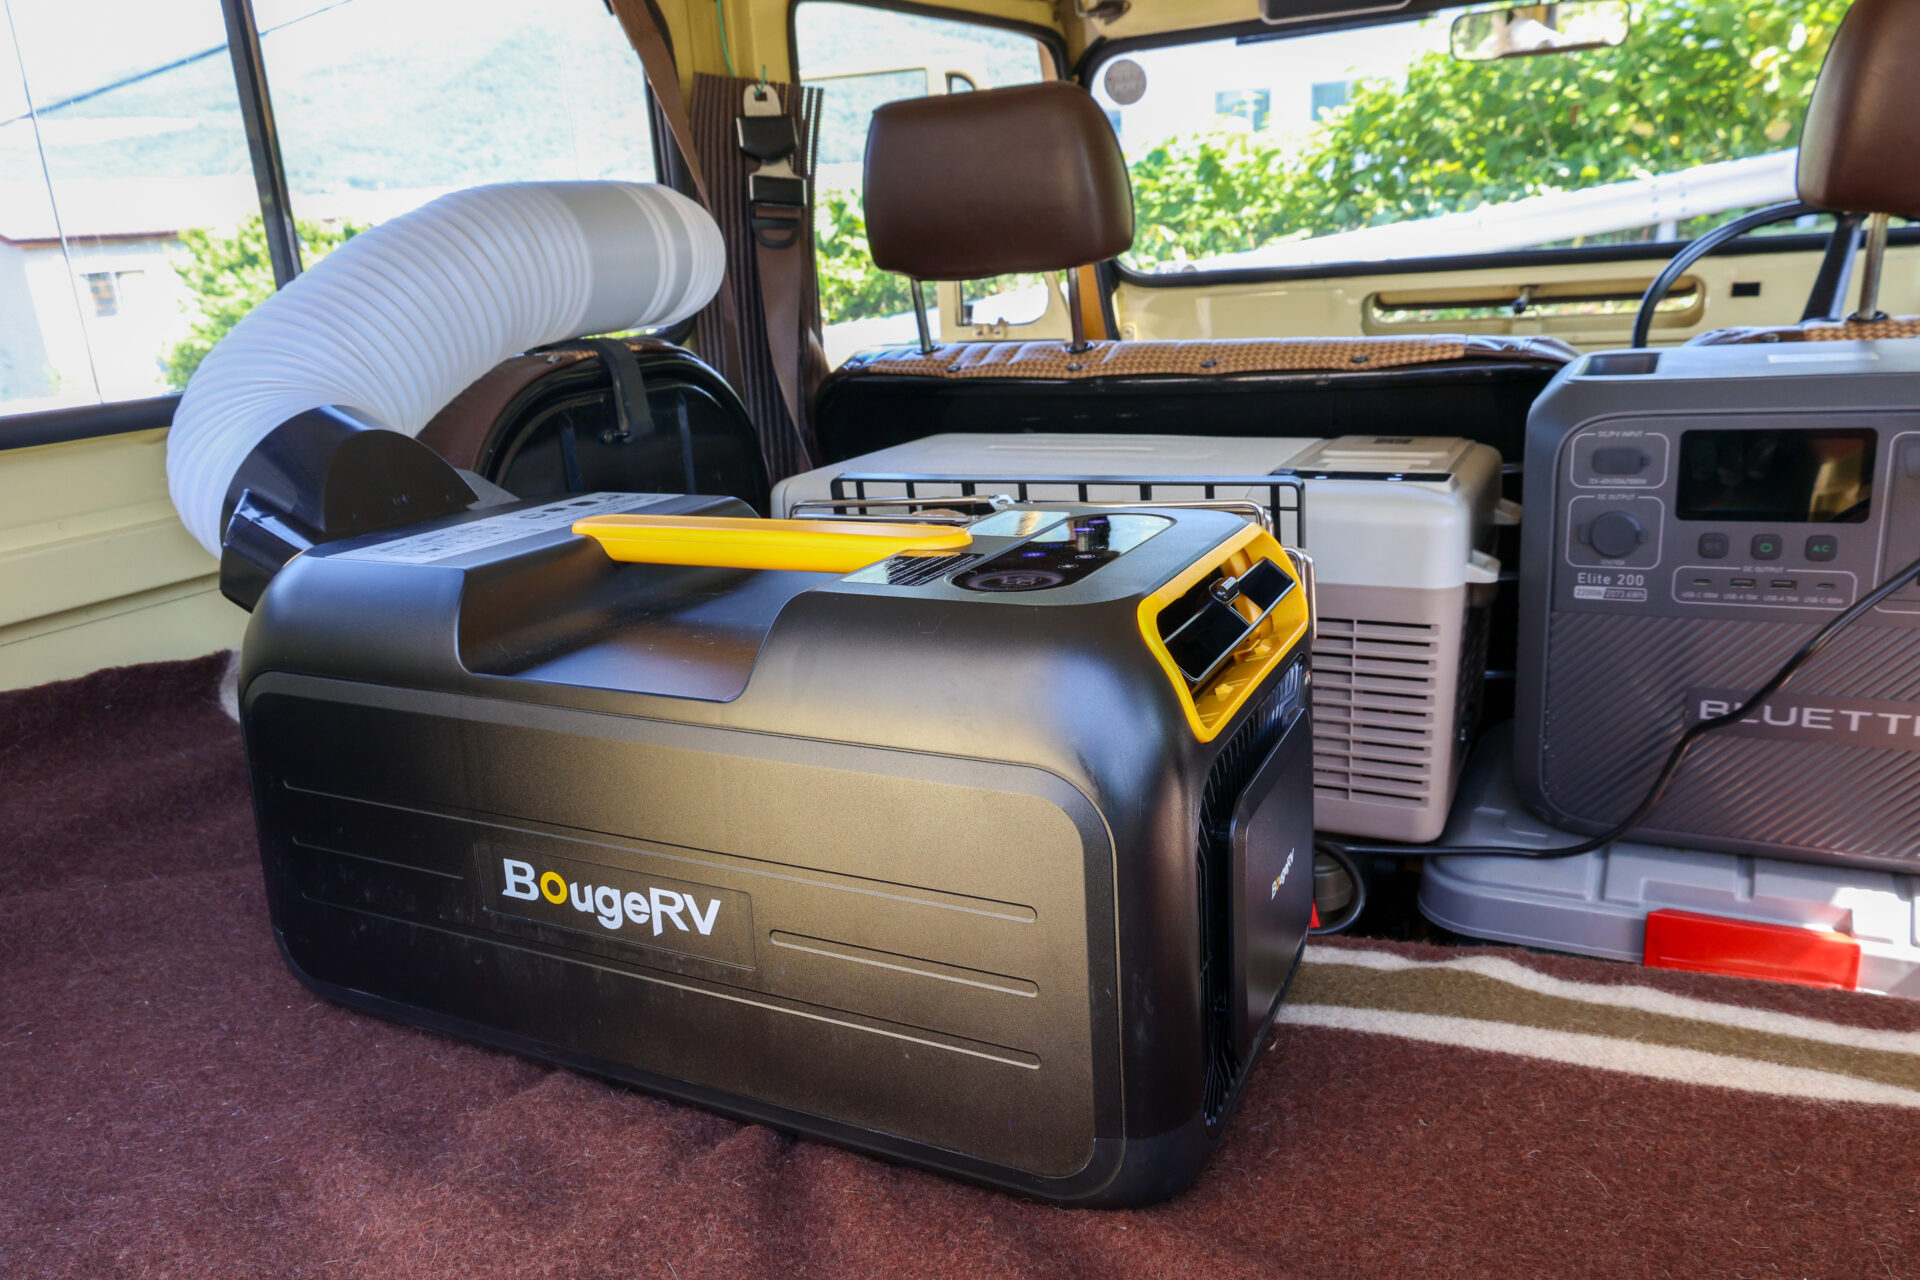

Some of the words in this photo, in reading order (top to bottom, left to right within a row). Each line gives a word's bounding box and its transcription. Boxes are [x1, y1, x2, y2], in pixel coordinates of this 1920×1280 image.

[1577, 572, 1612, 585] Elite
[1617, 574, 1645, 587] 200
[502, 858, 722, 937] BougeRV
